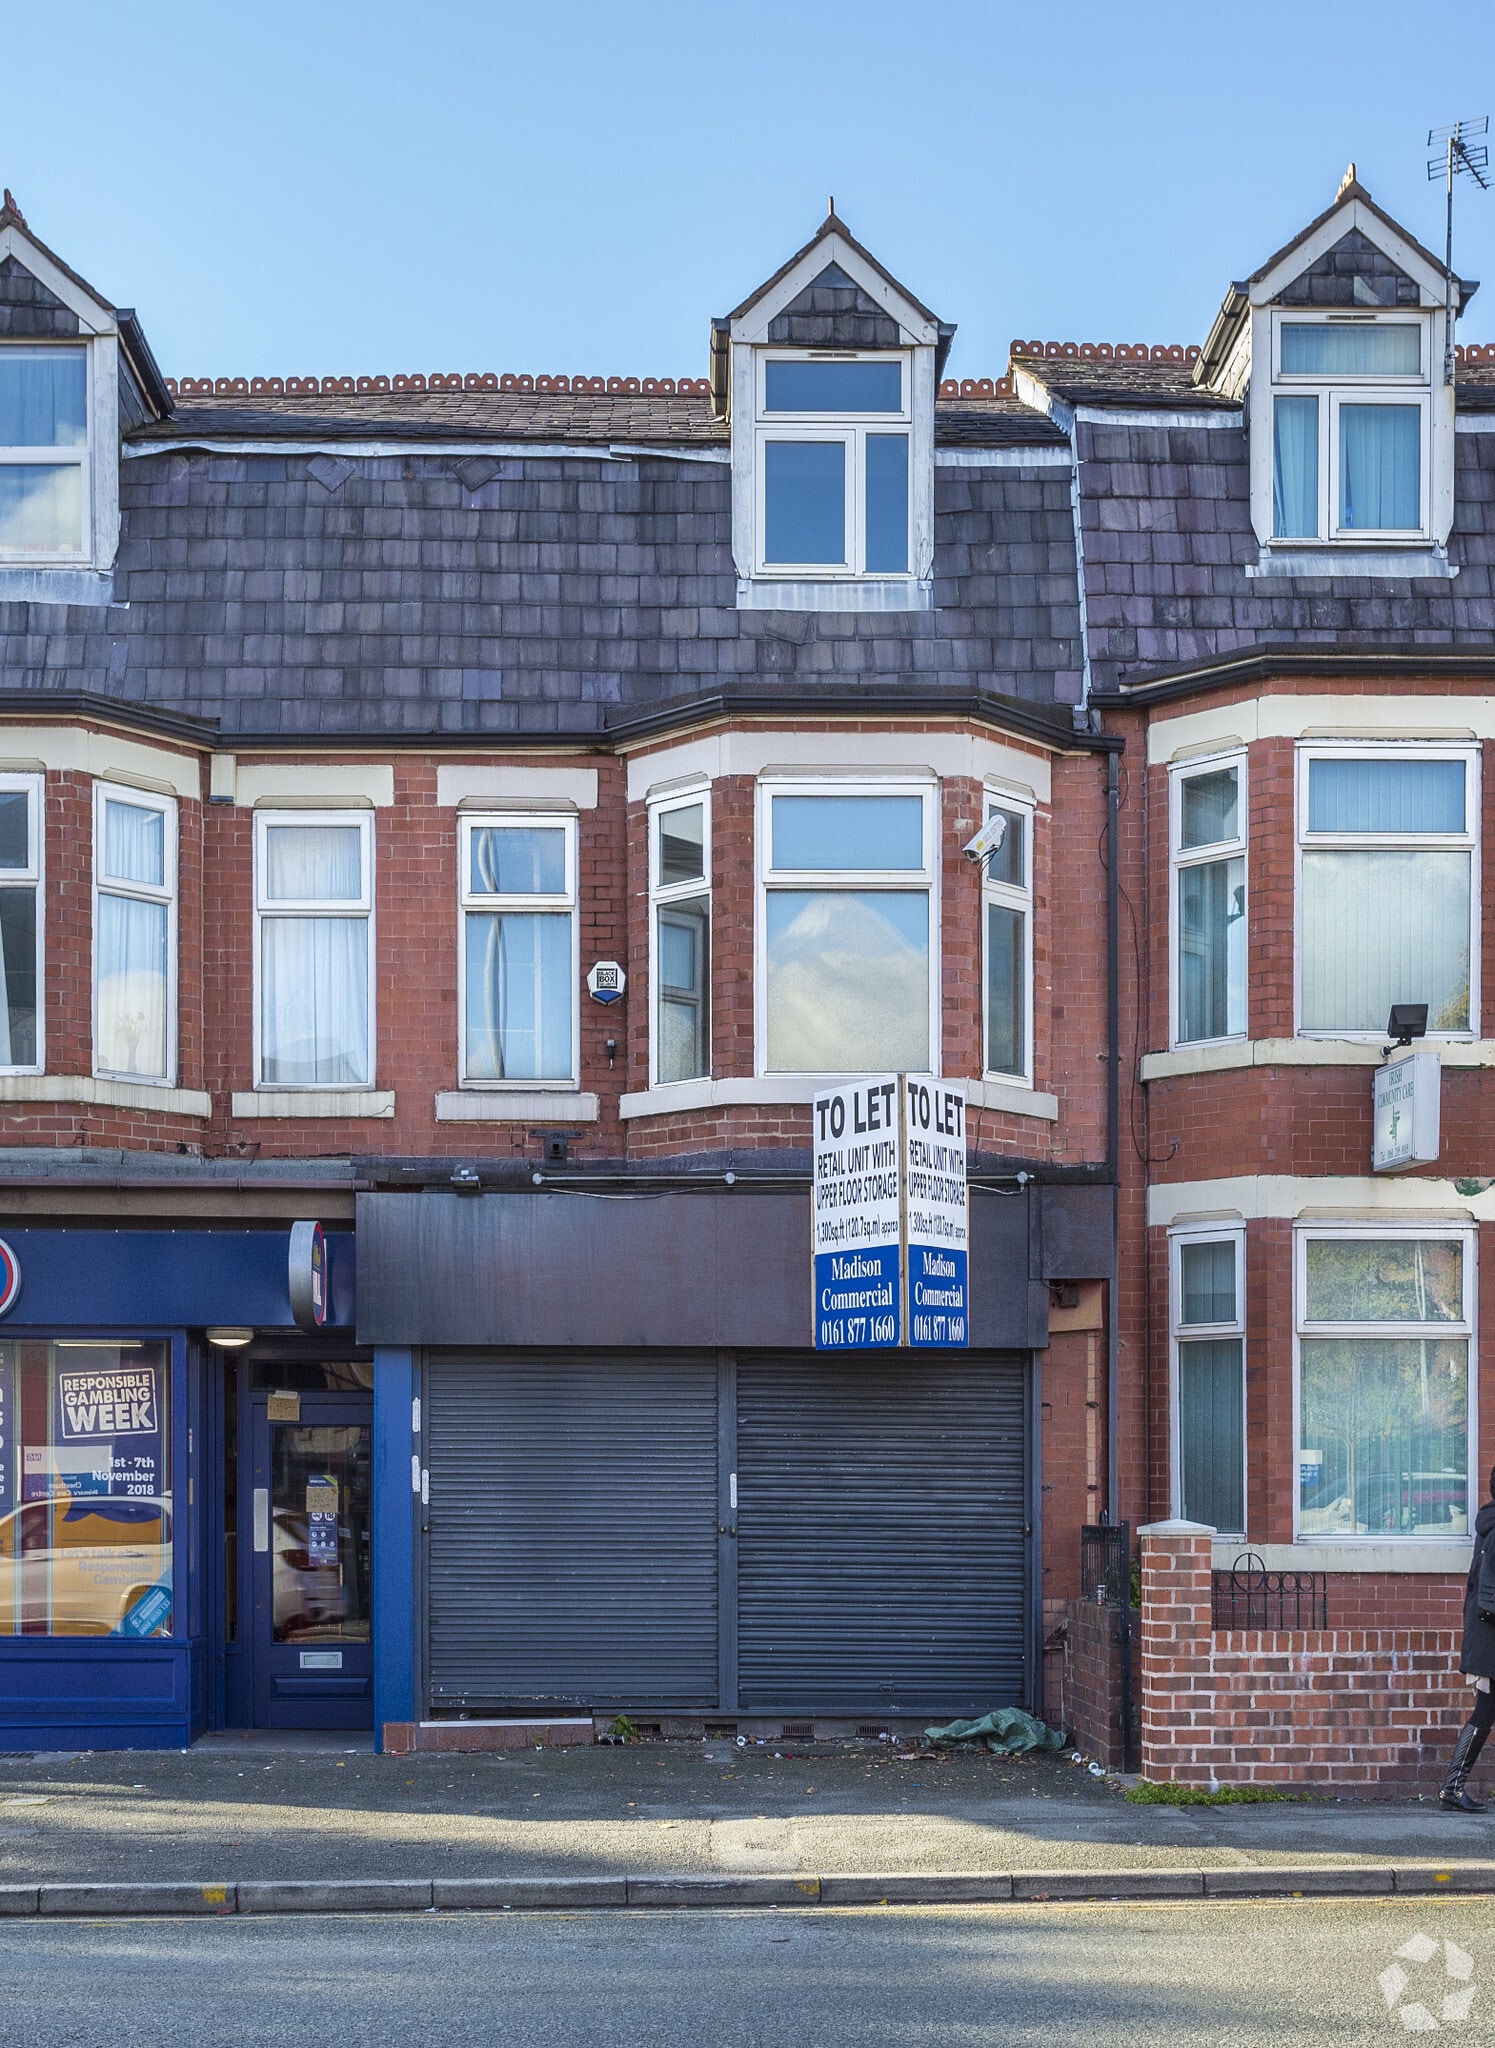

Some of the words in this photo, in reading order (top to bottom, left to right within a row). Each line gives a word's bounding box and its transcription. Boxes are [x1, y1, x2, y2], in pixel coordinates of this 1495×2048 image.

[1389, 1068, 1402, 1086] IRISH
[1377, 1086, 1402, 1109] COMMUNITY
[1402, 1082, 1414, 1099] CARE
[816, 1095, 845, 1141] TO
[853, 1082, 896, 1134] LET
[907, 1082, 931, 1131] TO
[935, 1090, 964, 1137] LET
[817, 1149, 846, 1180] RETAIL
[847, 1144, 870, 1175] UNIT
[871, 1139, 896, 1170] WITH
[909, 1139, 933, 1170] RETAIL
[932, 1143, 948, 1173] UNIT
[948, 1147, 964, 1177] WITH
[816, 1181, 838, 1211] UPPER
[838, 1177, 862, 1207] FLOOR
[863, 1171, 898, 1203] STORAGE
[908, 1170, 928, 1200] UPPER
[927, 1174, 945, 1203] FLOOR
[944, 1177, 966, 1207] STORAGE
[816, 1217, 845, 1247] 1,300sq.ft
[845, 1213, 880, 1243] (120.7sq.m)
[881, 1220, 899, 1239] approx
[831, 1257, 882, 1281] Madison
[922, 1251, 956, 1277] Madison
[821, 1281, 894, 1312] Commercial
[914, 1281, 963, 1308] Commercial
[821, 1319, 845, 1346] 0161
[847, 1317, 867, 1344] 877
[869, 1314, 895, 1343] 1660
[913, 1314, 932, 1342] 0161
[932, 1316, 946, 1342] 877
[947, 1317, 965, 1343] 1660
[63, 1374, 150, 1392] RESPONSIBLE
[64, 1387, 151, 1406] GAMBLING
[66, 1402, 153, 1433] WEEK
[109, 1456, 126, 1468] 1st
[134, 1456, 155, 1468] 7th
[92, 1470, 155, 1482] November
[127, 1484, 155, 1496] 2018
[60, 1548, 90, 1559] Let's
[91, 1548, 115, 1559] talk
[78, 1560, 153, 1574] Responsible
